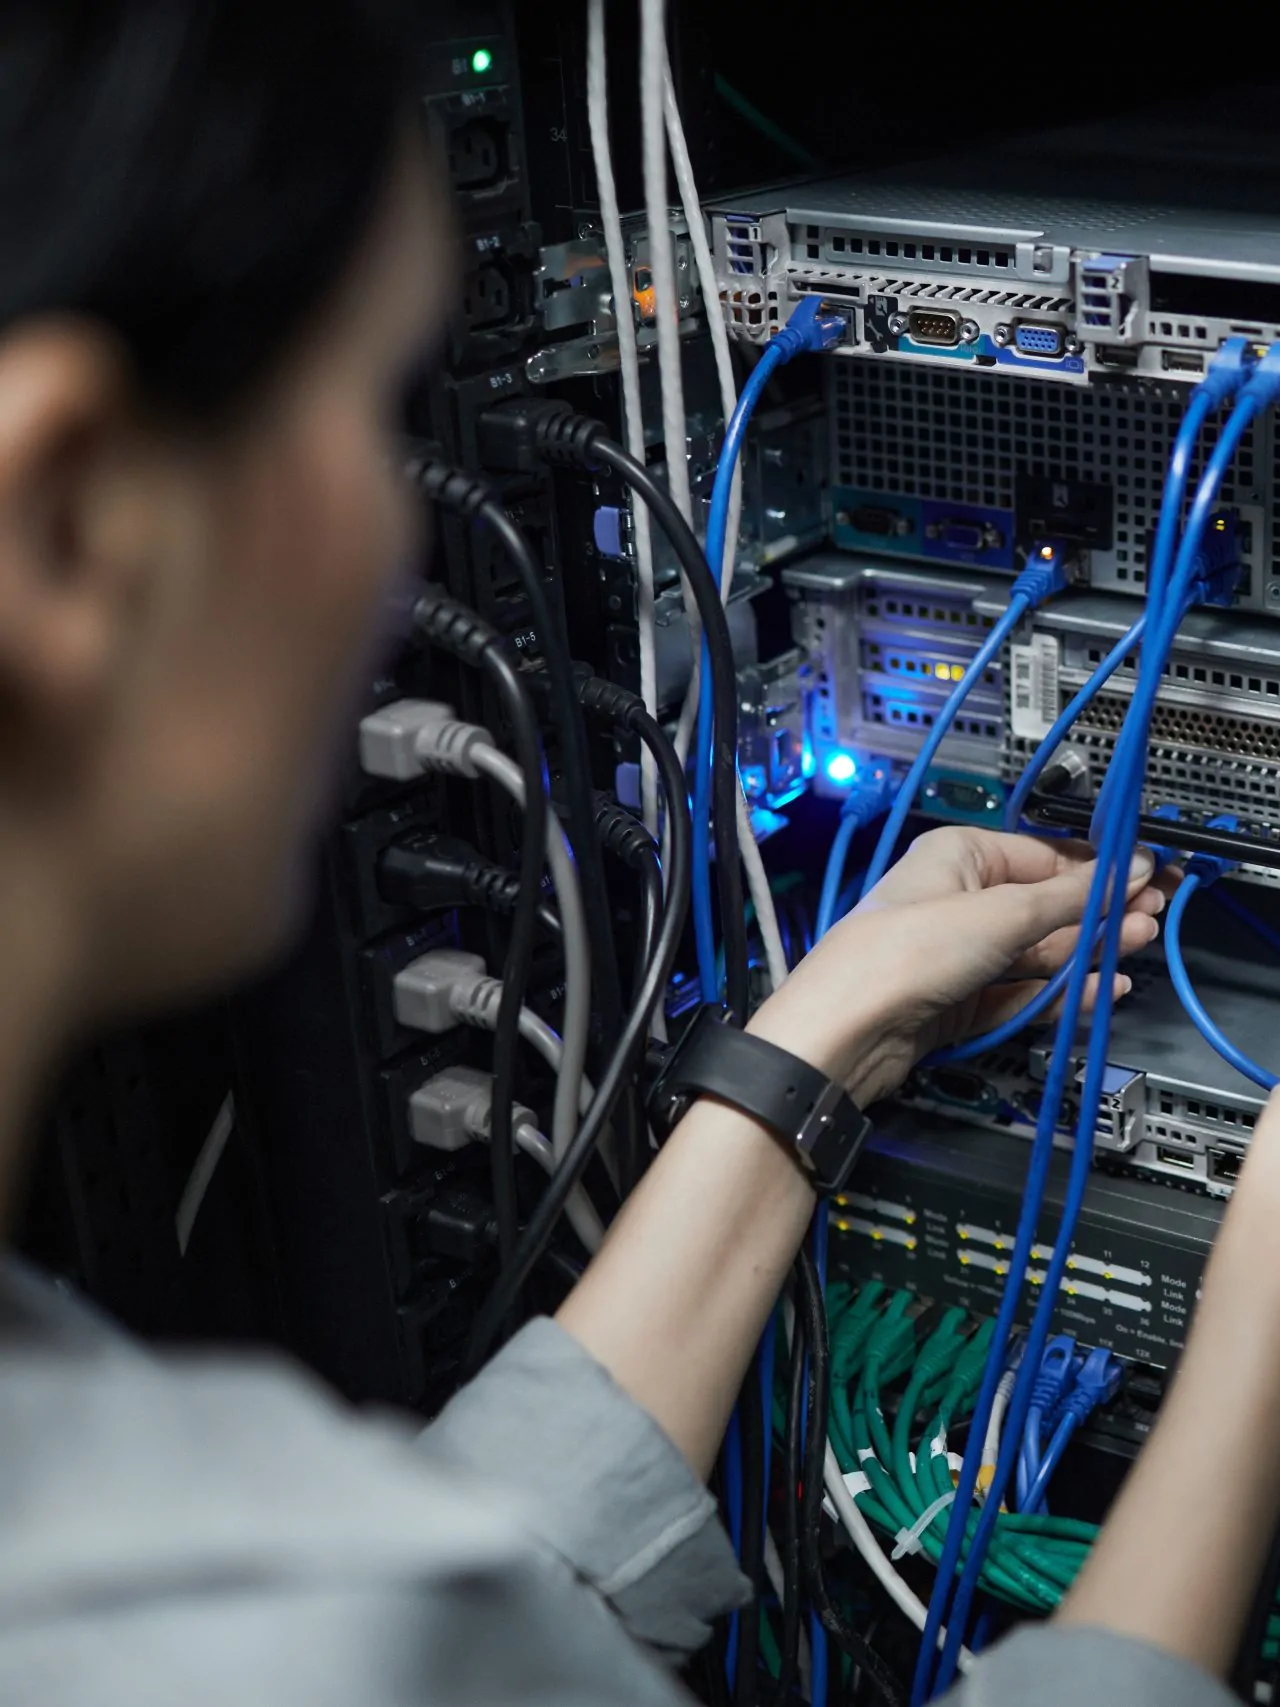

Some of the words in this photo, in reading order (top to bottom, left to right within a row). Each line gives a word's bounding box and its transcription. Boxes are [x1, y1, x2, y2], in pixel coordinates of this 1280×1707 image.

[550, 126, 568, 143] 34
[752, 226, 759, 240] 1
[1111, 277, 1120, 290] 2
[1111, 1097, 1121, 1110] 2
[1139, 1259, 1151, 1270] 12
[1160, 1273, 1188, 1290] Mode
[1163, 1287, 1185, 1302] Link
[1160, 1299, 1188, 1315] Mode
[1162, 1313, 1185, 1328] Link
